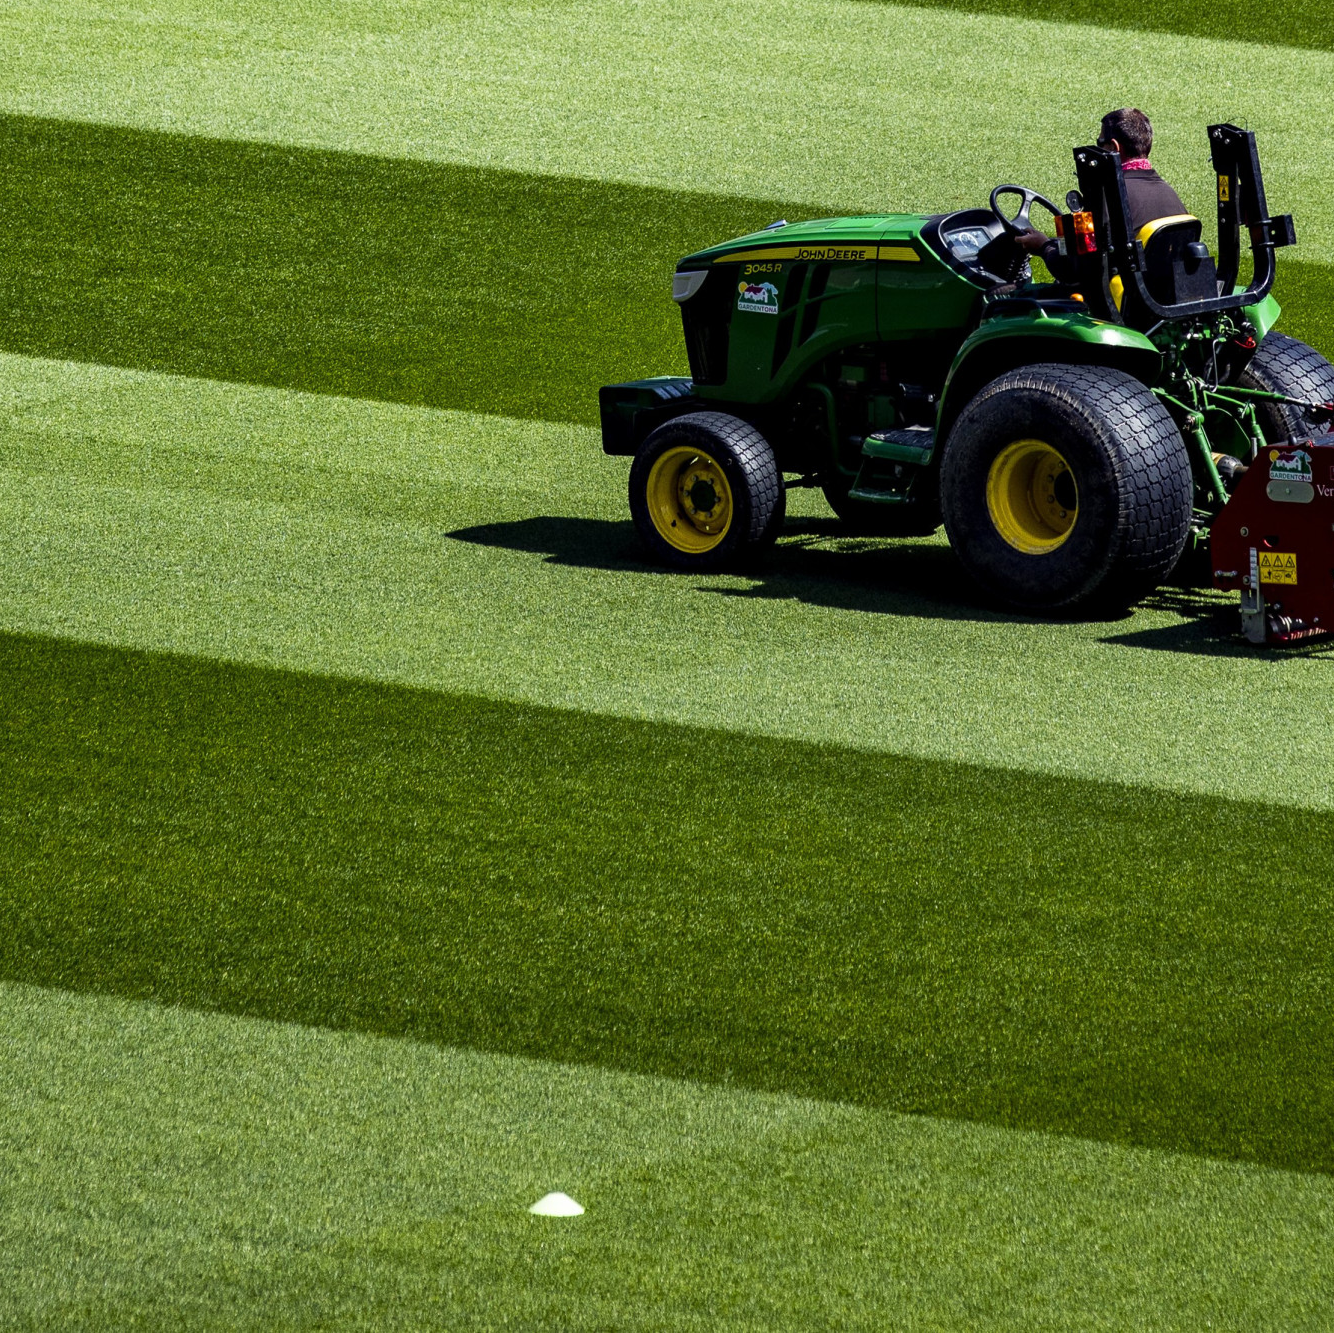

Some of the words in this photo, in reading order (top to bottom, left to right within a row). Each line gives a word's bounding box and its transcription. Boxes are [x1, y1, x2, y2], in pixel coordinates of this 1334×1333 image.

[795, 248, 826, 260] JOHN
[826, 248, 866, 260] DEERE
[738, 303, 778, 314] GARDENTONA
[1270, 471, 1312, 482] GARDENTONA
